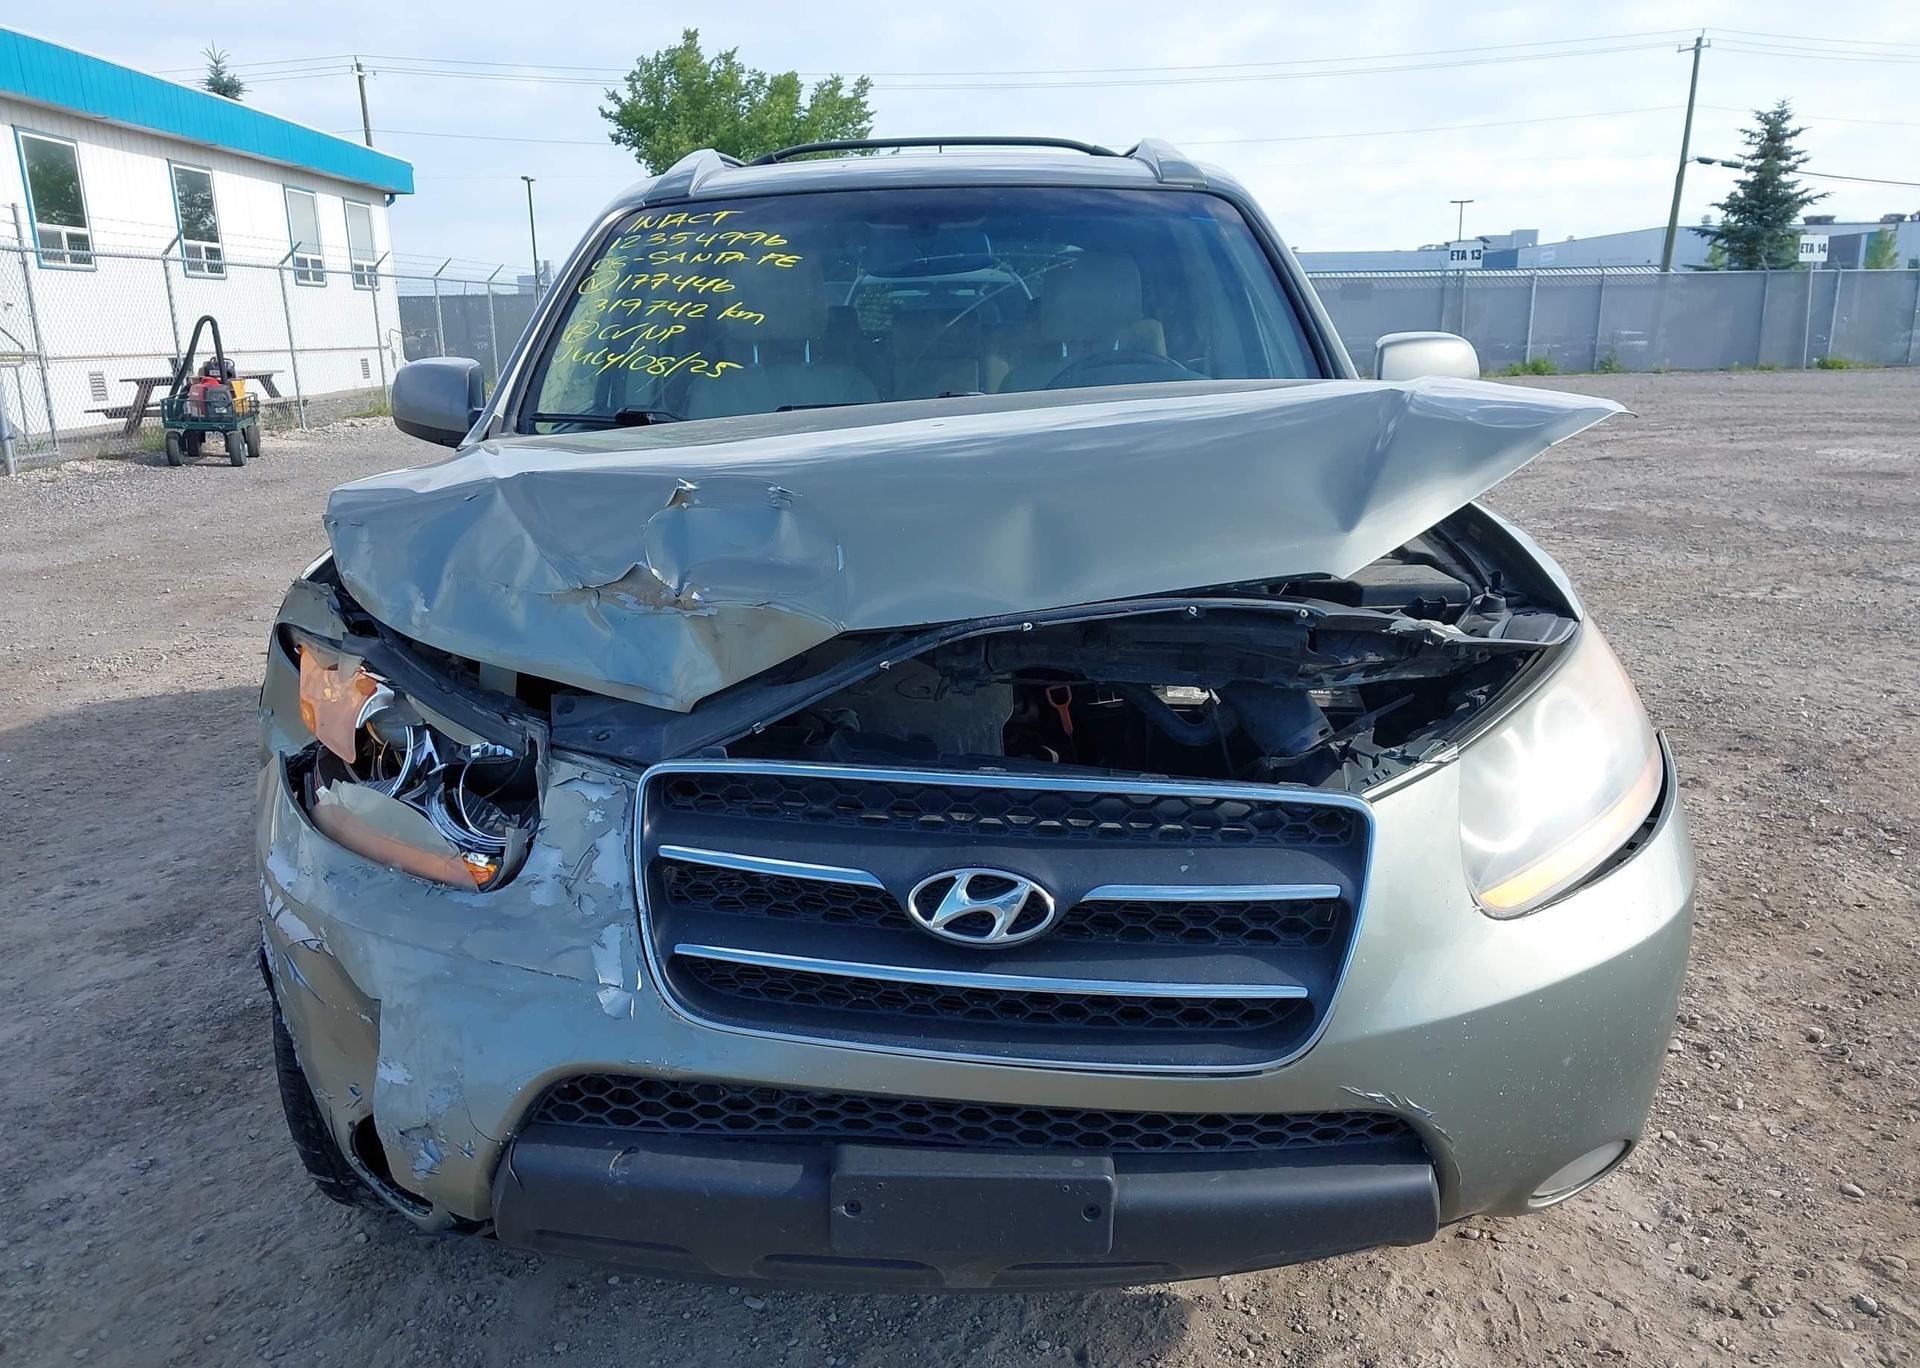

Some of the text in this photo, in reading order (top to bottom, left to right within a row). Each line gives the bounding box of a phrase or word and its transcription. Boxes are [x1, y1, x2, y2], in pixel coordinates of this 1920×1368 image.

[624, 211, 744, 233] INTACT
[609, 231, 788, 250] 12354996
[1800, 242, 1827, 254] ETA 14
[1450, 249, 1482, 261] ETA 13
